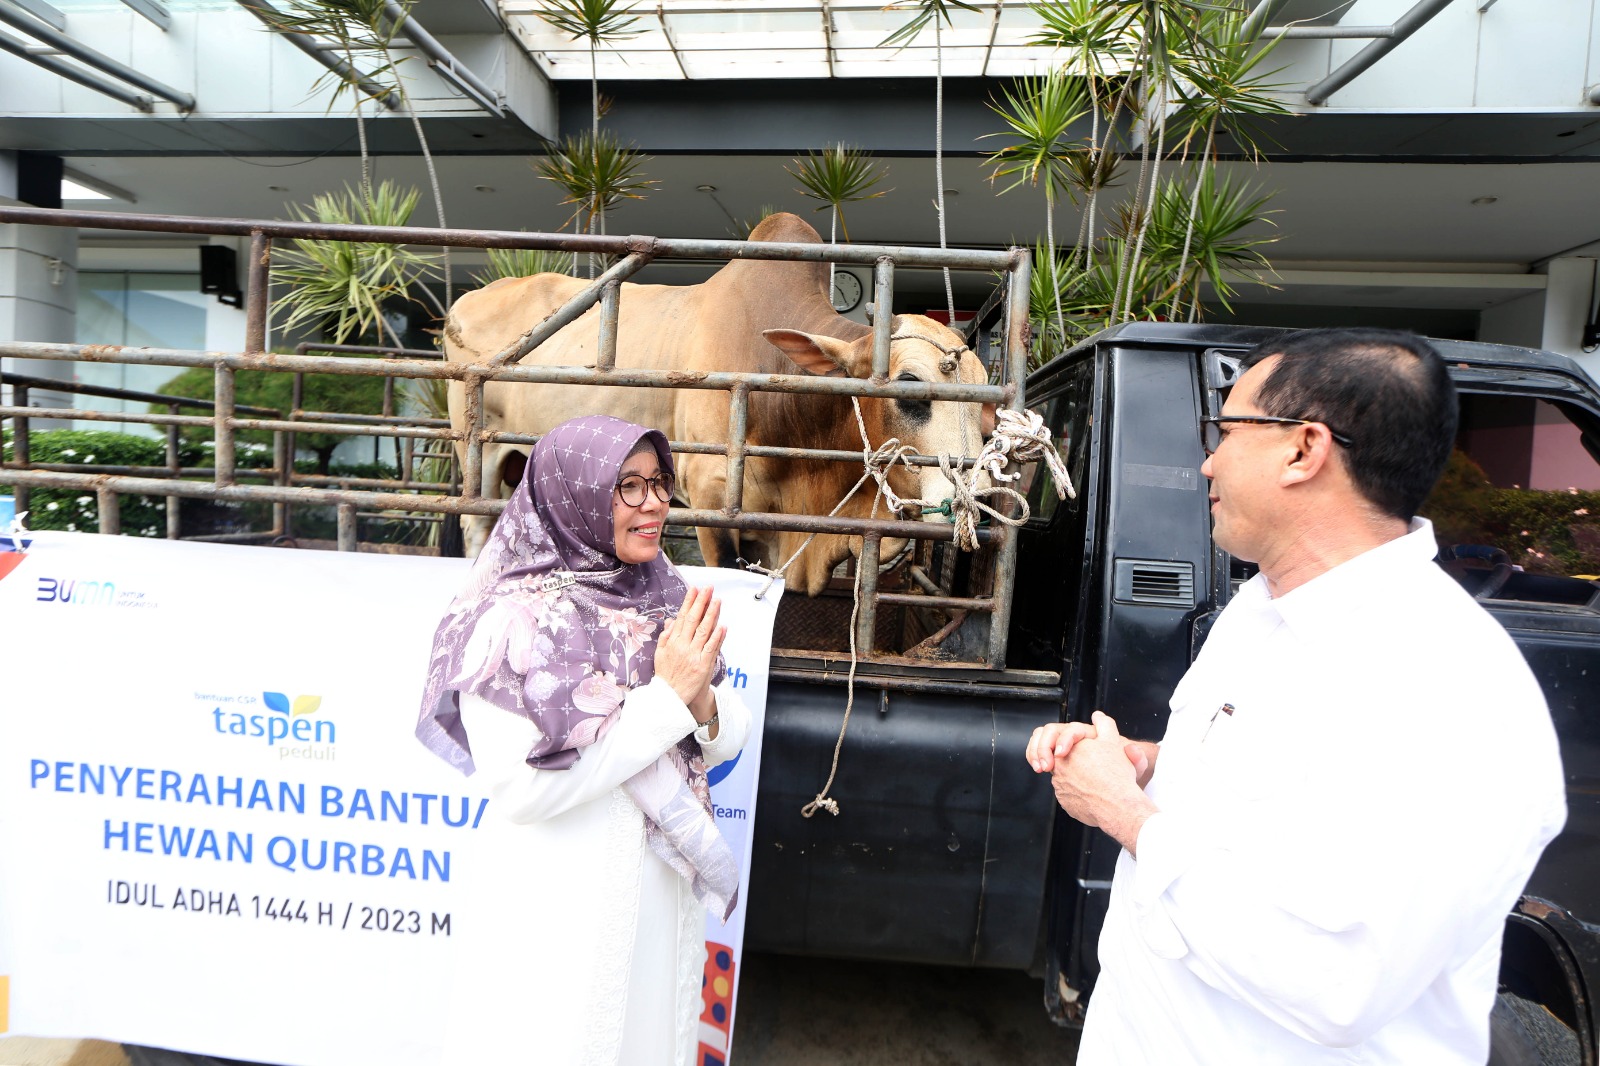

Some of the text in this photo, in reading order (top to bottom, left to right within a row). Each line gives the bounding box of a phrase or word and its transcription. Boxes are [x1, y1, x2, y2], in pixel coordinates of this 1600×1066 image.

[543, 575, 575, 590] taspen
[194, 691, 257, 705] bantuan CSR
[212, 706, 336, 746] taspen
[279, 745, 336, 761] peduli
[30, 759, 305, 814] PENYERAHAN
[711, 804, 746, 820] Team
[103, 819, 452, 882] HEWAN QURBAN
[107, 880, 452, 937] IDUL ADHA 1444 H / 2023 M
